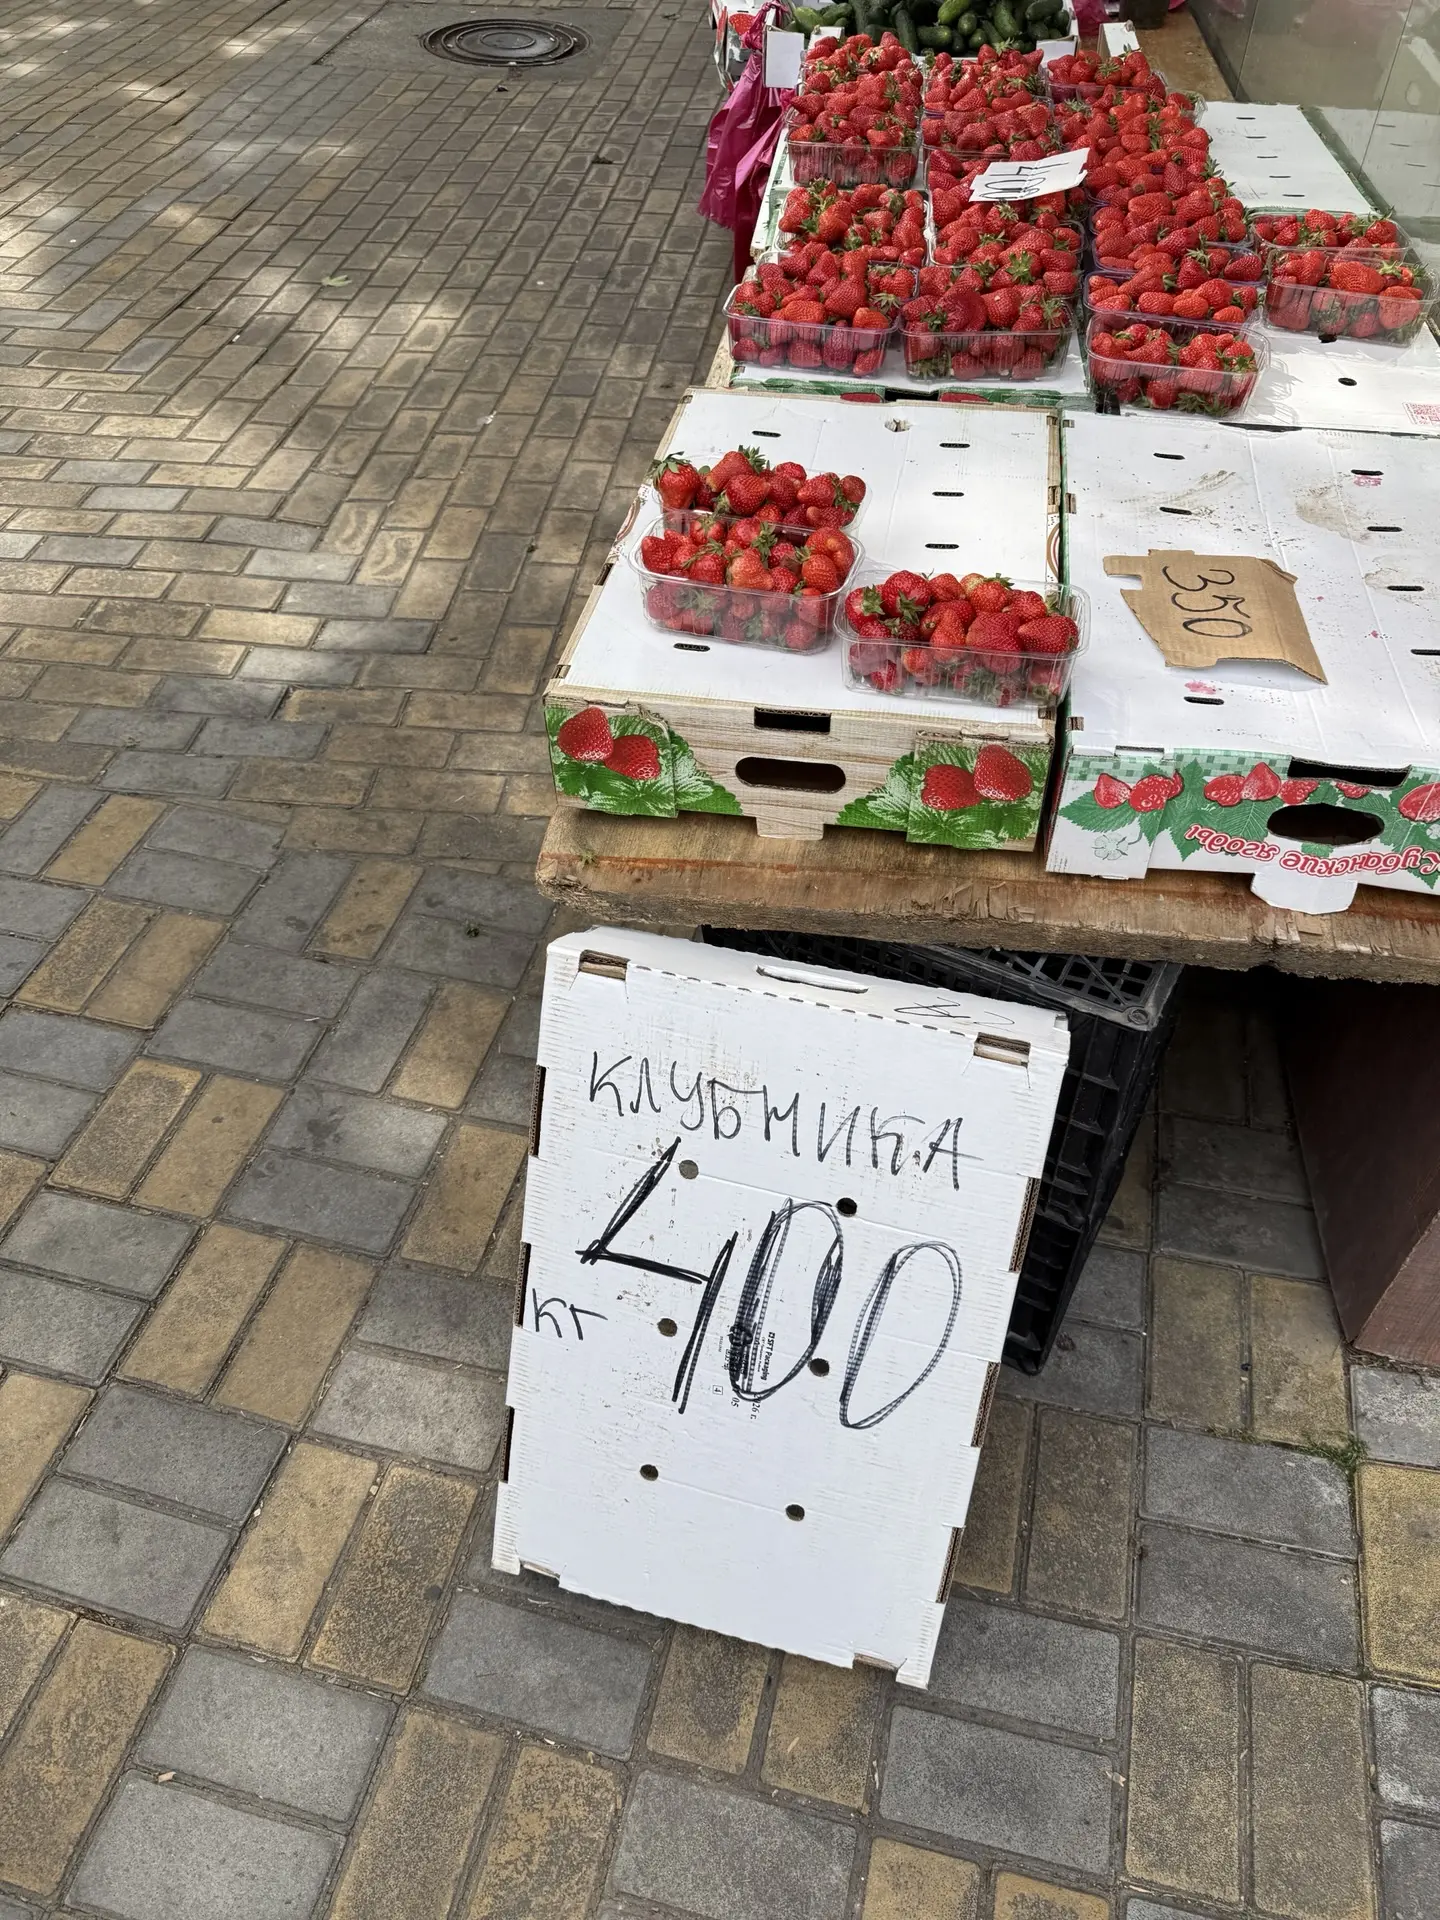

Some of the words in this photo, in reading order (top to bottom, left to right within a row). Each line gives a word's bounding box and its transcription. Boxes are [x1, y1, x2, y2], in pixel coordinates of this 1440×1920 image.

[1161, 565, 1254, 639] 350
[1184, 823, 1281, 864] ягоды
[575, 1135, 963, 1431] 400
